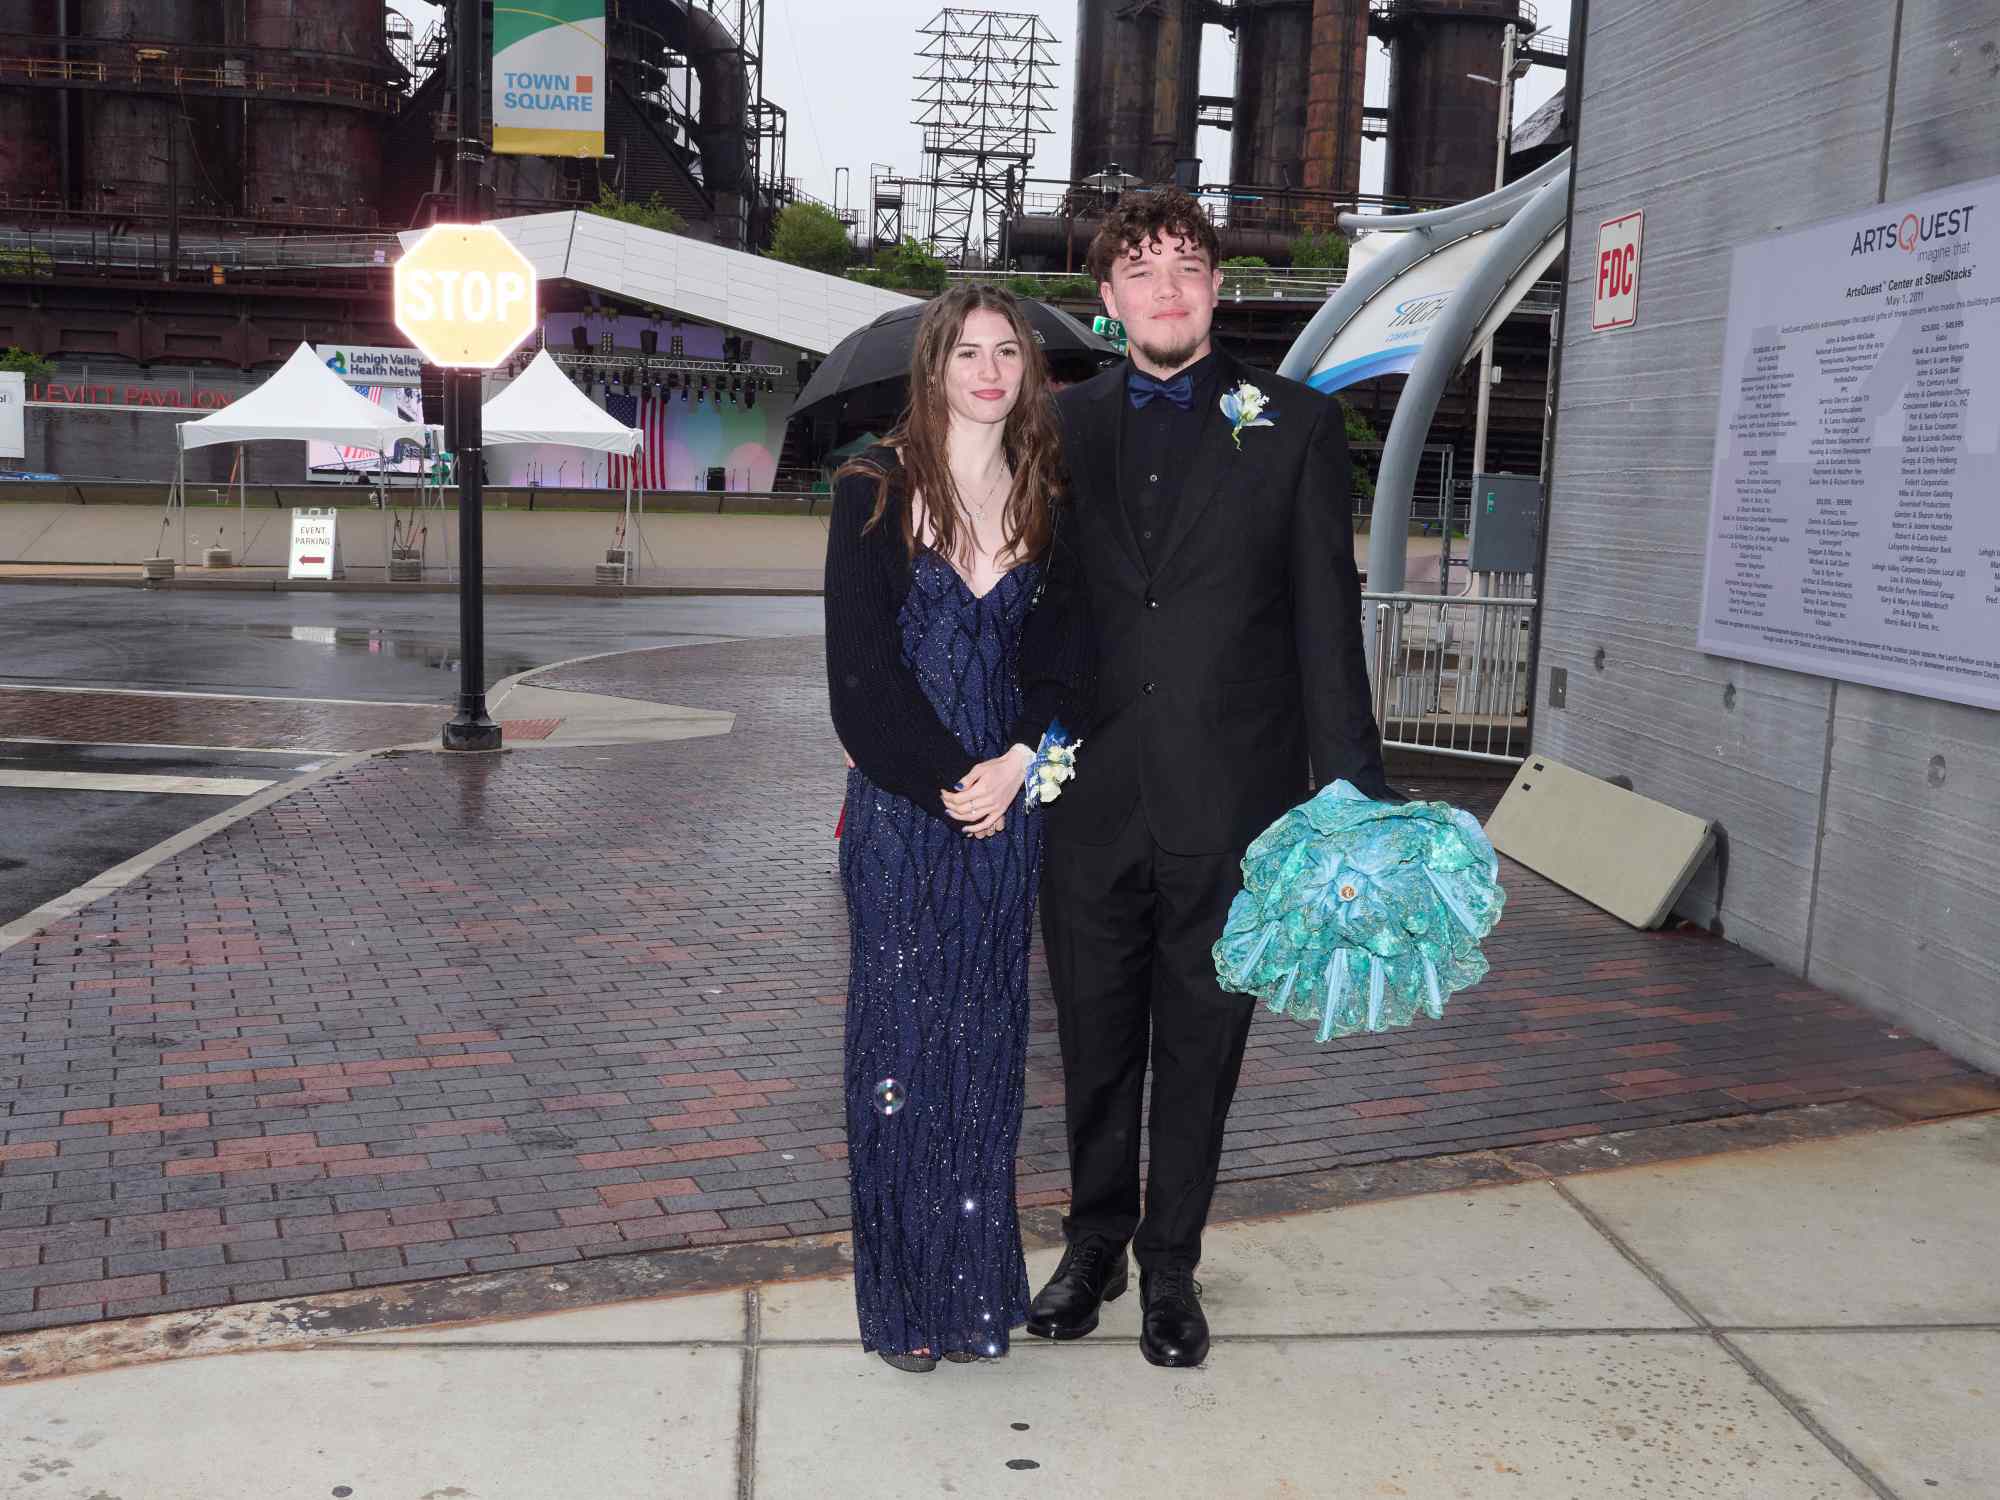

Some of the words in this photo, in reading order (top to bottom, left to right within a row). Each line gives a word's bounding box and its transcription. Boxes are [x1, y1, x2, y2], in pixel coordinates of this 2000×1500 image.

[504, 73, 569, 90] TOWN
[504, 93, 592, 112] SQUARE
[1851, 205, 1974, 256] ARTSQUEST
[1918, 247, 1950, 262] imagine
[1599, 243, 1635, 300] FDC
[1888, 277, 1914, 291] Center
[1915, 276, 1923, 287] at
[404, 270, 525, 321] STOP
[1886, 295, 1899, 306] May
[1910, 291, 1924, 302] 2011
[1108, 321, 1120, 336] St
[350, 352, 388, 365] Lehigh
[390, 353, 423, 368] Valley
[350, 364, 387, 375] Health
[33, 383, 115, 405] LEVITT
[124, 385, 234, 410] PAVILION
[295, 537, 331, 545] PARKING
